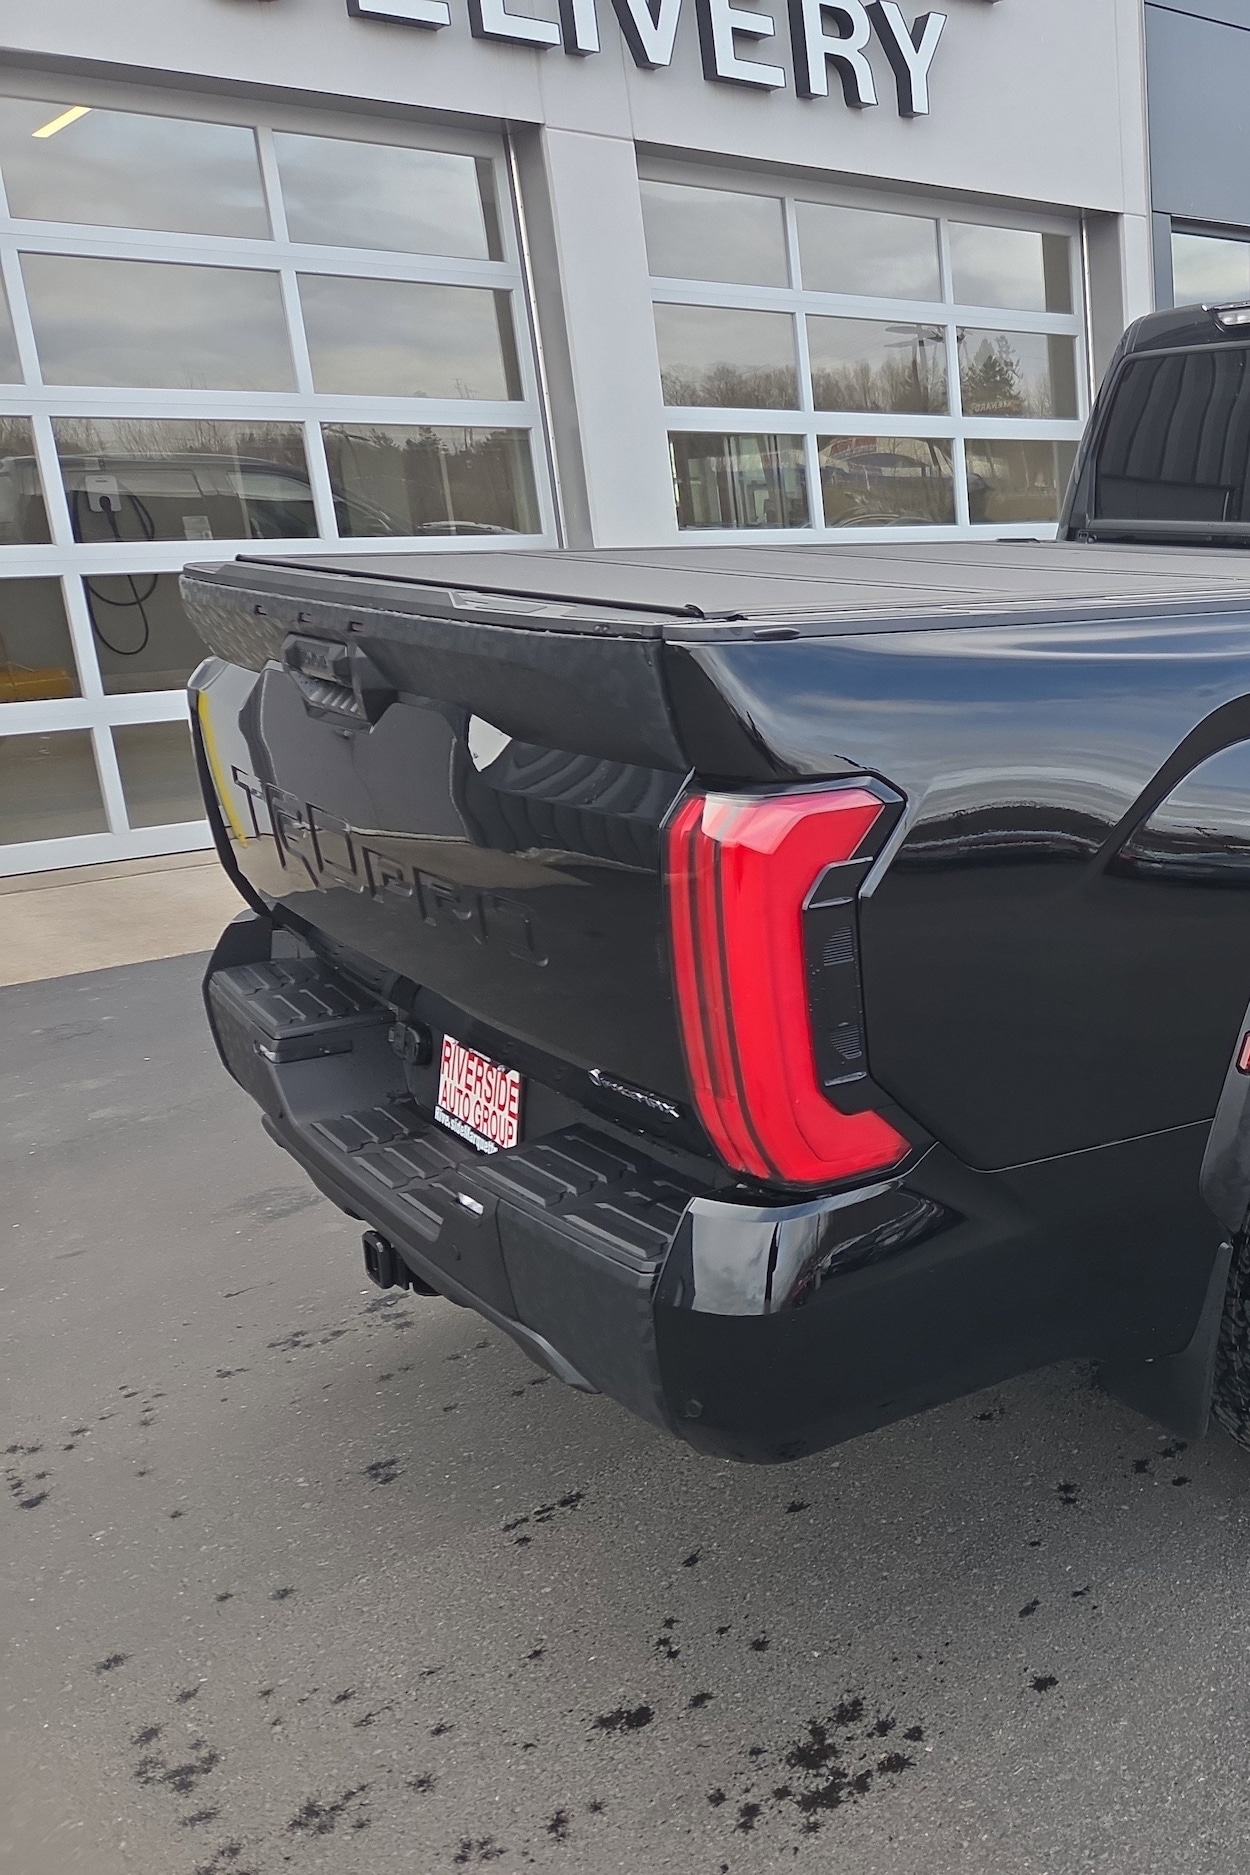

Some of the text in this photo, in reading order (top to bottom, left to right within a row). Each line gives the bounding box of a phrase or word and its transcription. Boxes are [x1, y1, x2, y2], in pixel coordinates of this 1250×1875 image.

[441, 1039, 520, 1120] RIVERSIDE
[441, 1080, 514, 1147] AUTO GROUP
